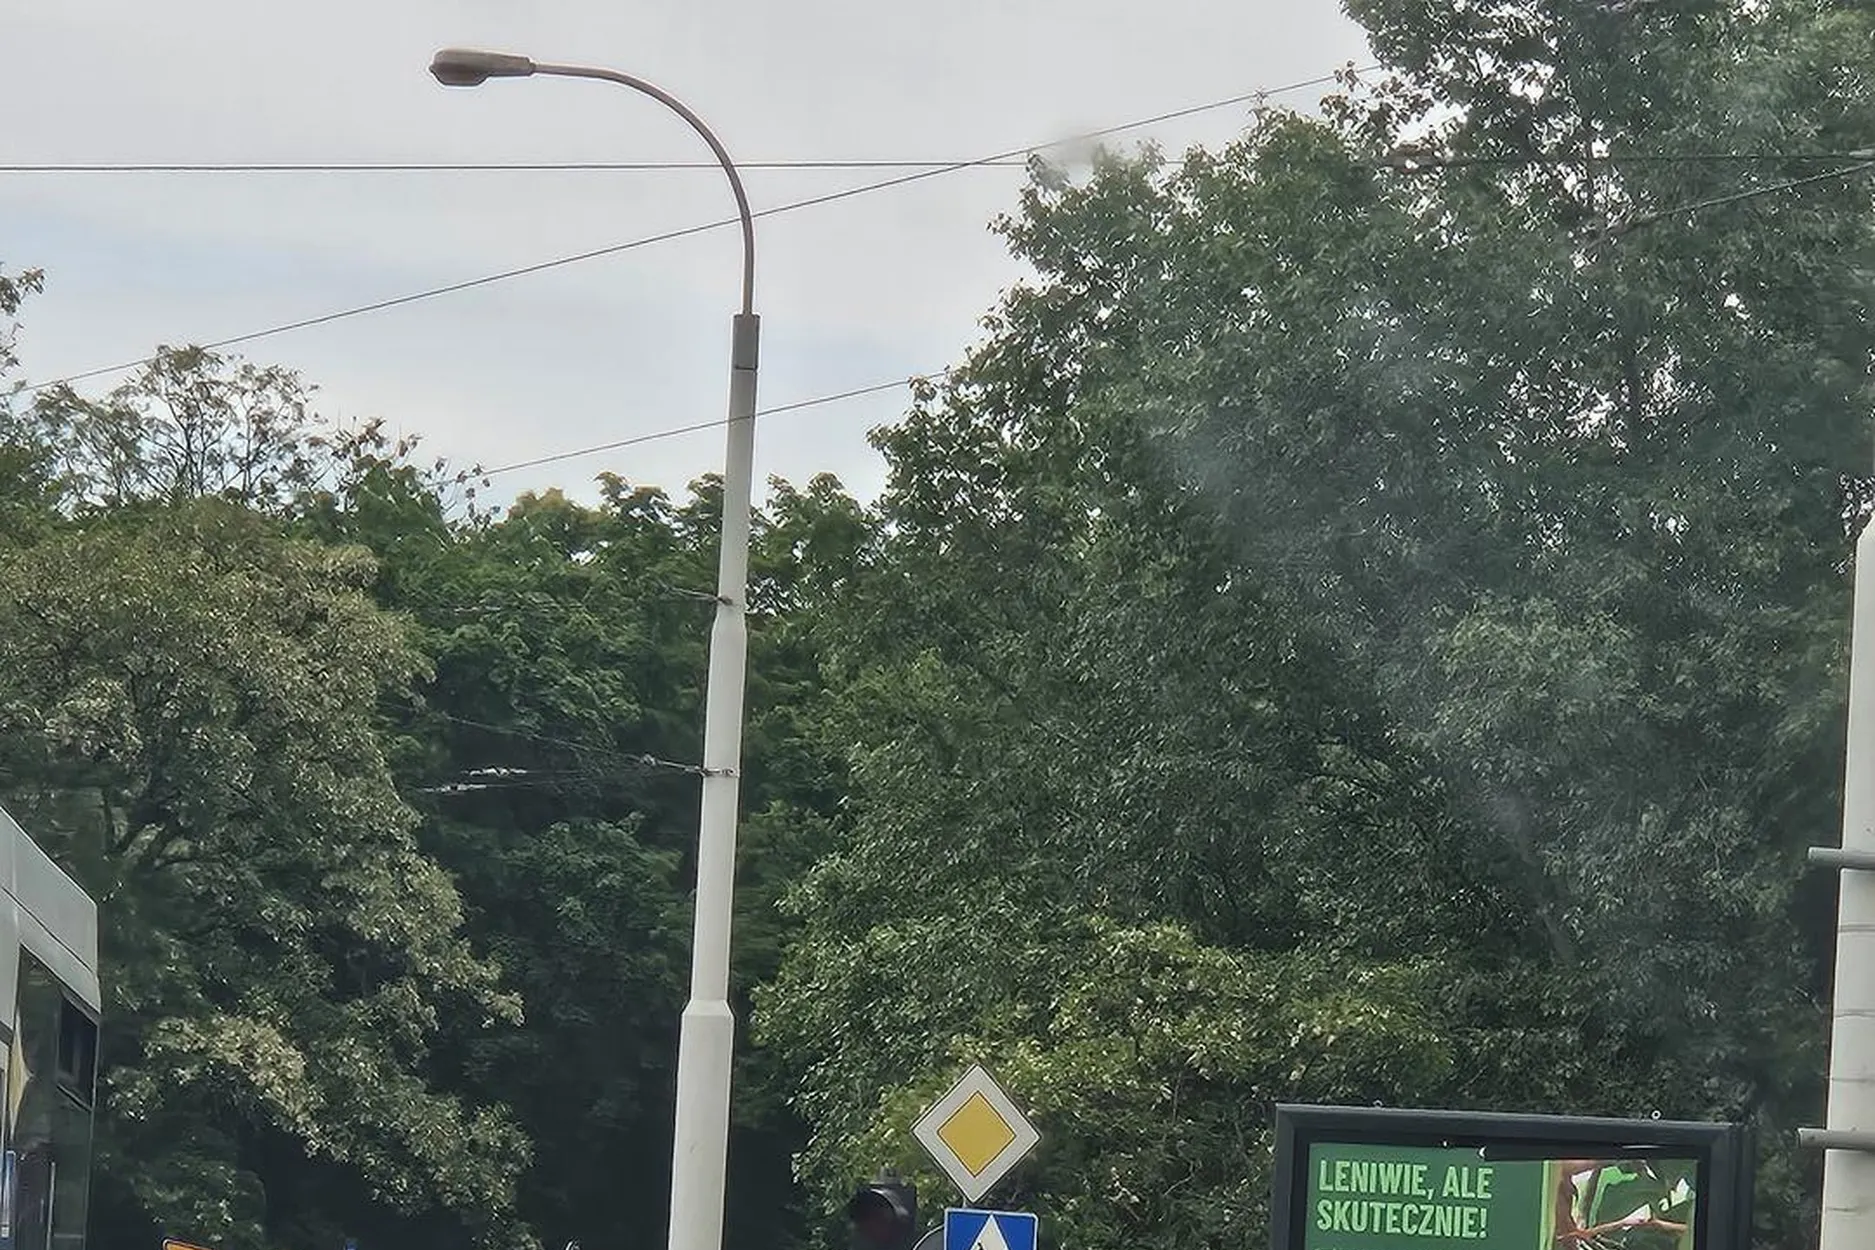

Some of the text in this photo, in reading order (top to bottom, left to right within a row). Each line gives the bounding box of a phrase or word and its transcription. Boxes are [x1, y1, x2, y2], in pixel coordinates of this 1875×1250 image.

[1318, 1159, 1494, 1200] LENIWIE, ALE
[1316, 1199, 1488, 1239] SKUTECZNIE!
